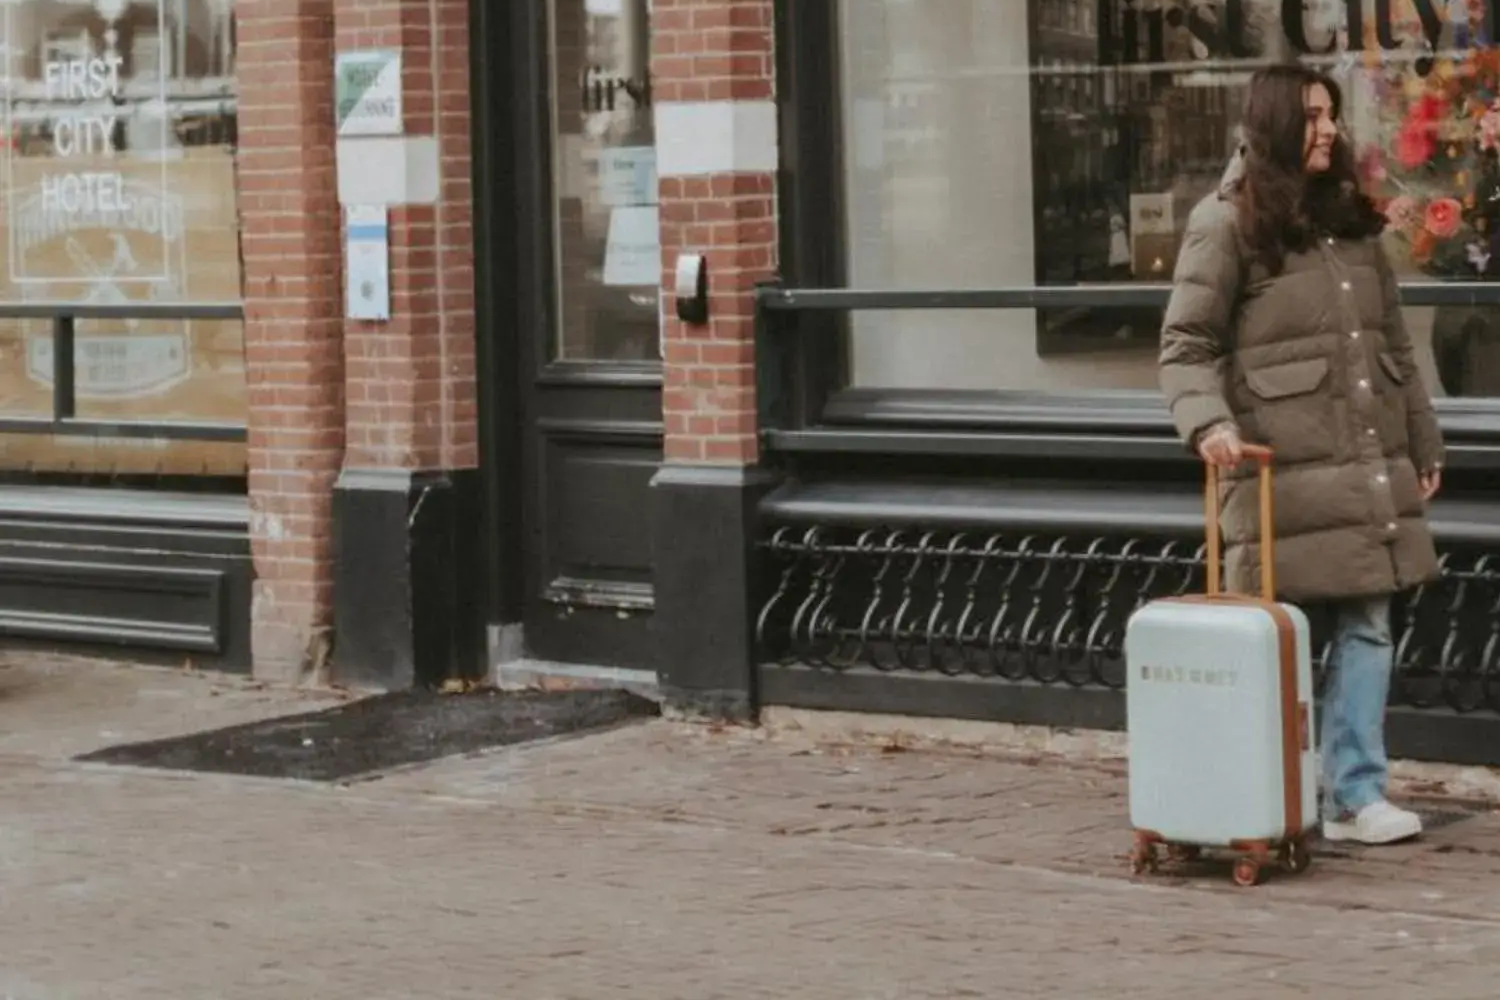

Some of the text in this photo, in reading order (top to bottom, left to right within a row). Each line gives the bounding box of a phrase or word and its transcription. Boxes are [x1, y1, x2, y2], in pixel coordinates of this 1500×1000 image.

[45, 55, 124, 99] FIRST
[54, 114, 117, 158] CITY
[41, 172, 132, 214] HOTEL
